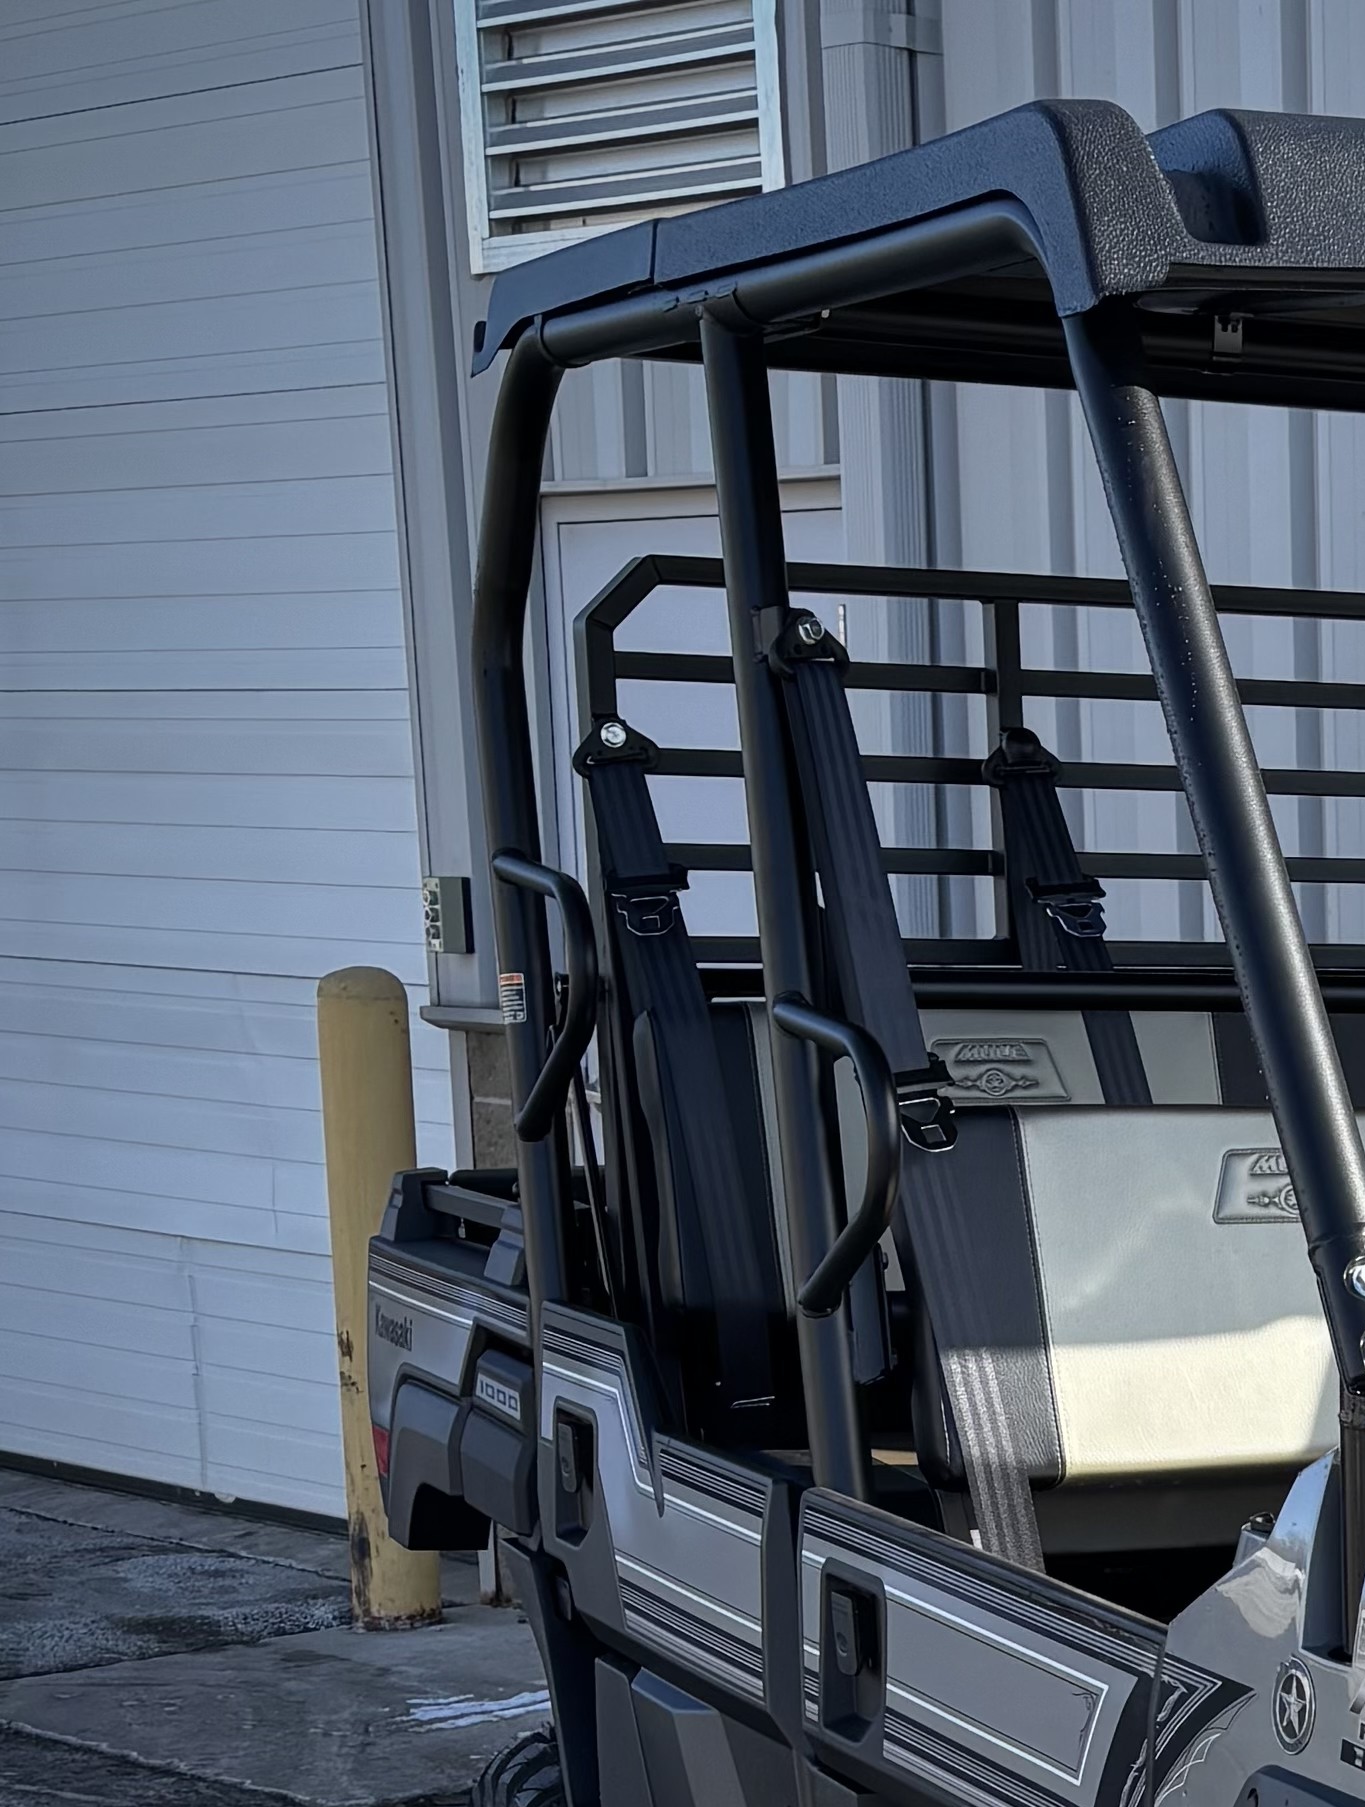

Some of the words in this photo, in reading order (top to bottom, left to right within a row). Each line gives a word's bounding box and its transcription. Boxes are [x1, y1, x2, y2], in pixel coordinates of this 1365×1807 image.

[1250, 1153, 1290, 1176] MU
[375, 1304, 413, 1352] Kawasaki
[479, 1379, 519, 1412] 1000
